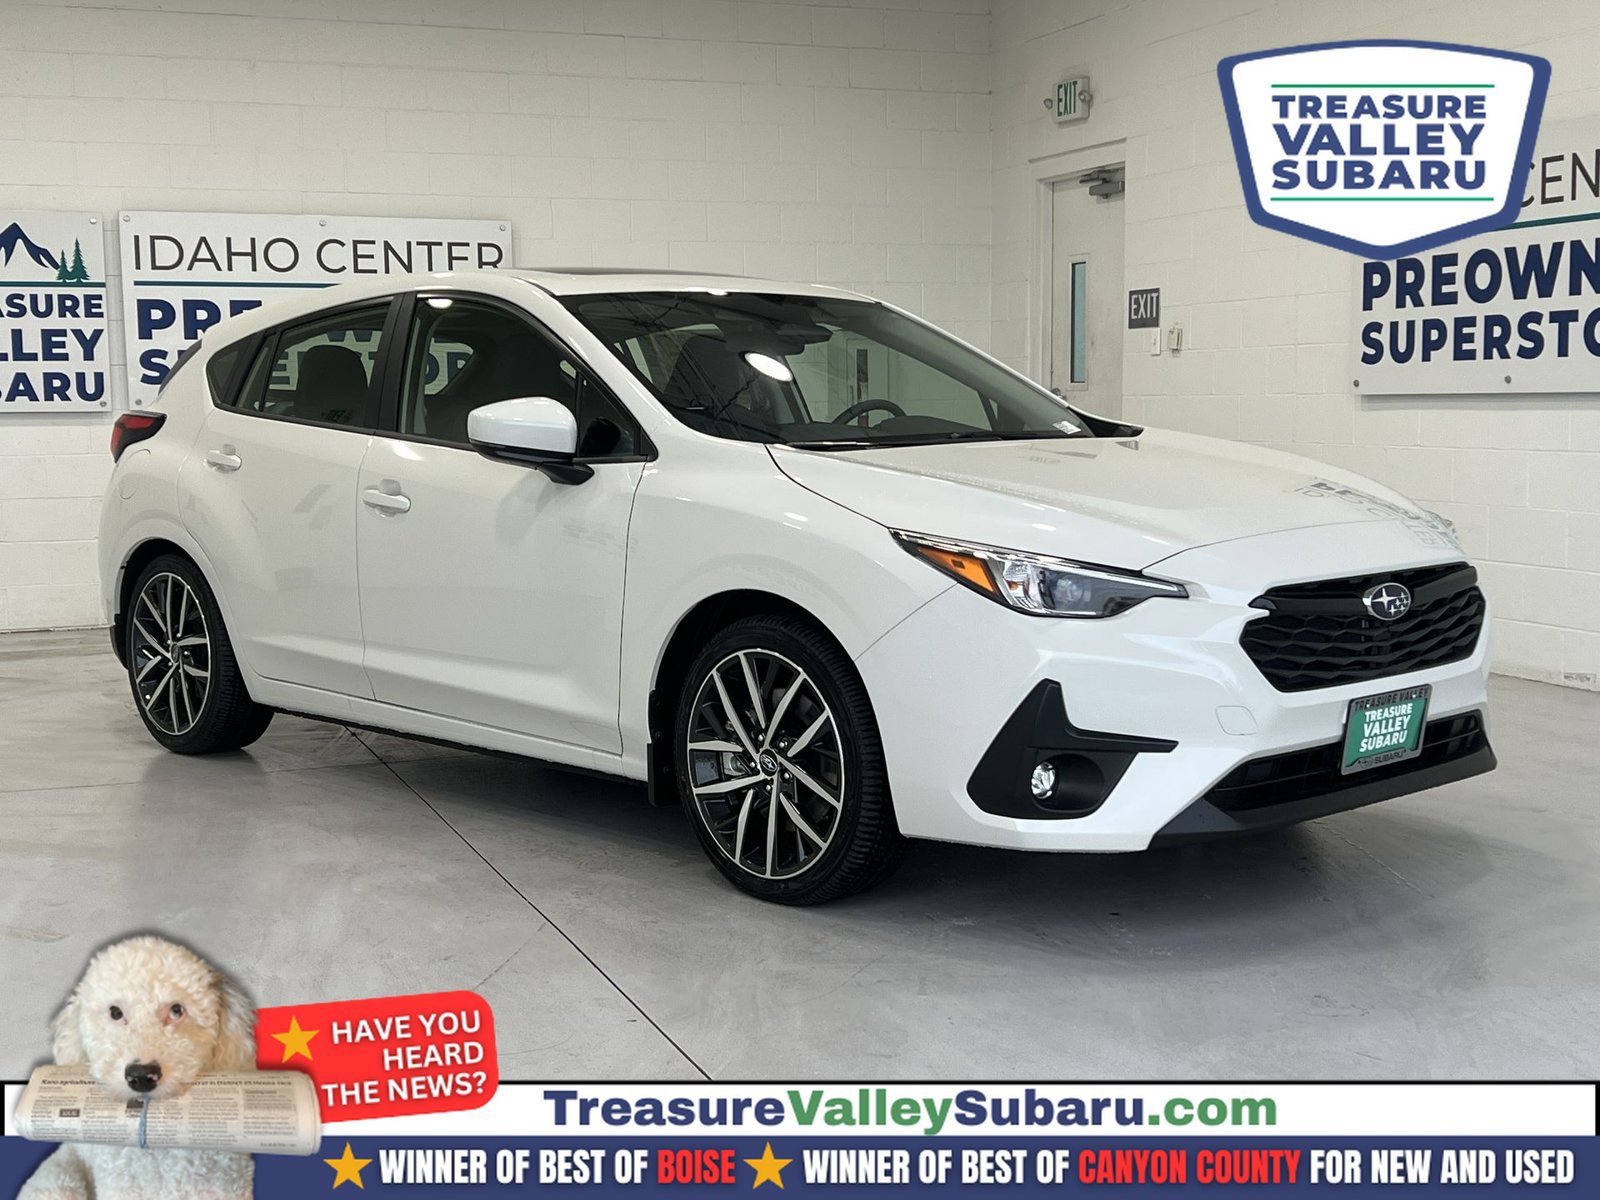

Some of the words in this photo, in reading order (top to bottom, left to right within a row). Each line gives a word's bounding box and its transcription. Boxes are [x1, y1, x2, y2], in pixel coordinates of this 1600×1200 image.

[1057, 81, 1078, 117] EXIT
[133, 234, 300, 273] IDAHO
[316, 238, 504, 275] CENTER
[1362, 237, 1600, 312] PREOWN
[0, 293, 105, 319] SURE
[1131, 292, 1158, 320] EXIT
[0, 371, 105, 402] ARU
[1355, 693, 1397, 711] TREASURE
[1400, 687, 1429, 702] VALLEY
[1365, 703, 1413, 722] TREASURE
[1363, 715, 1411, 738] VALLEY
[1359, 730, 1408, 752] SUBARU
[1374, 752, 1404, 764] SUBARU
